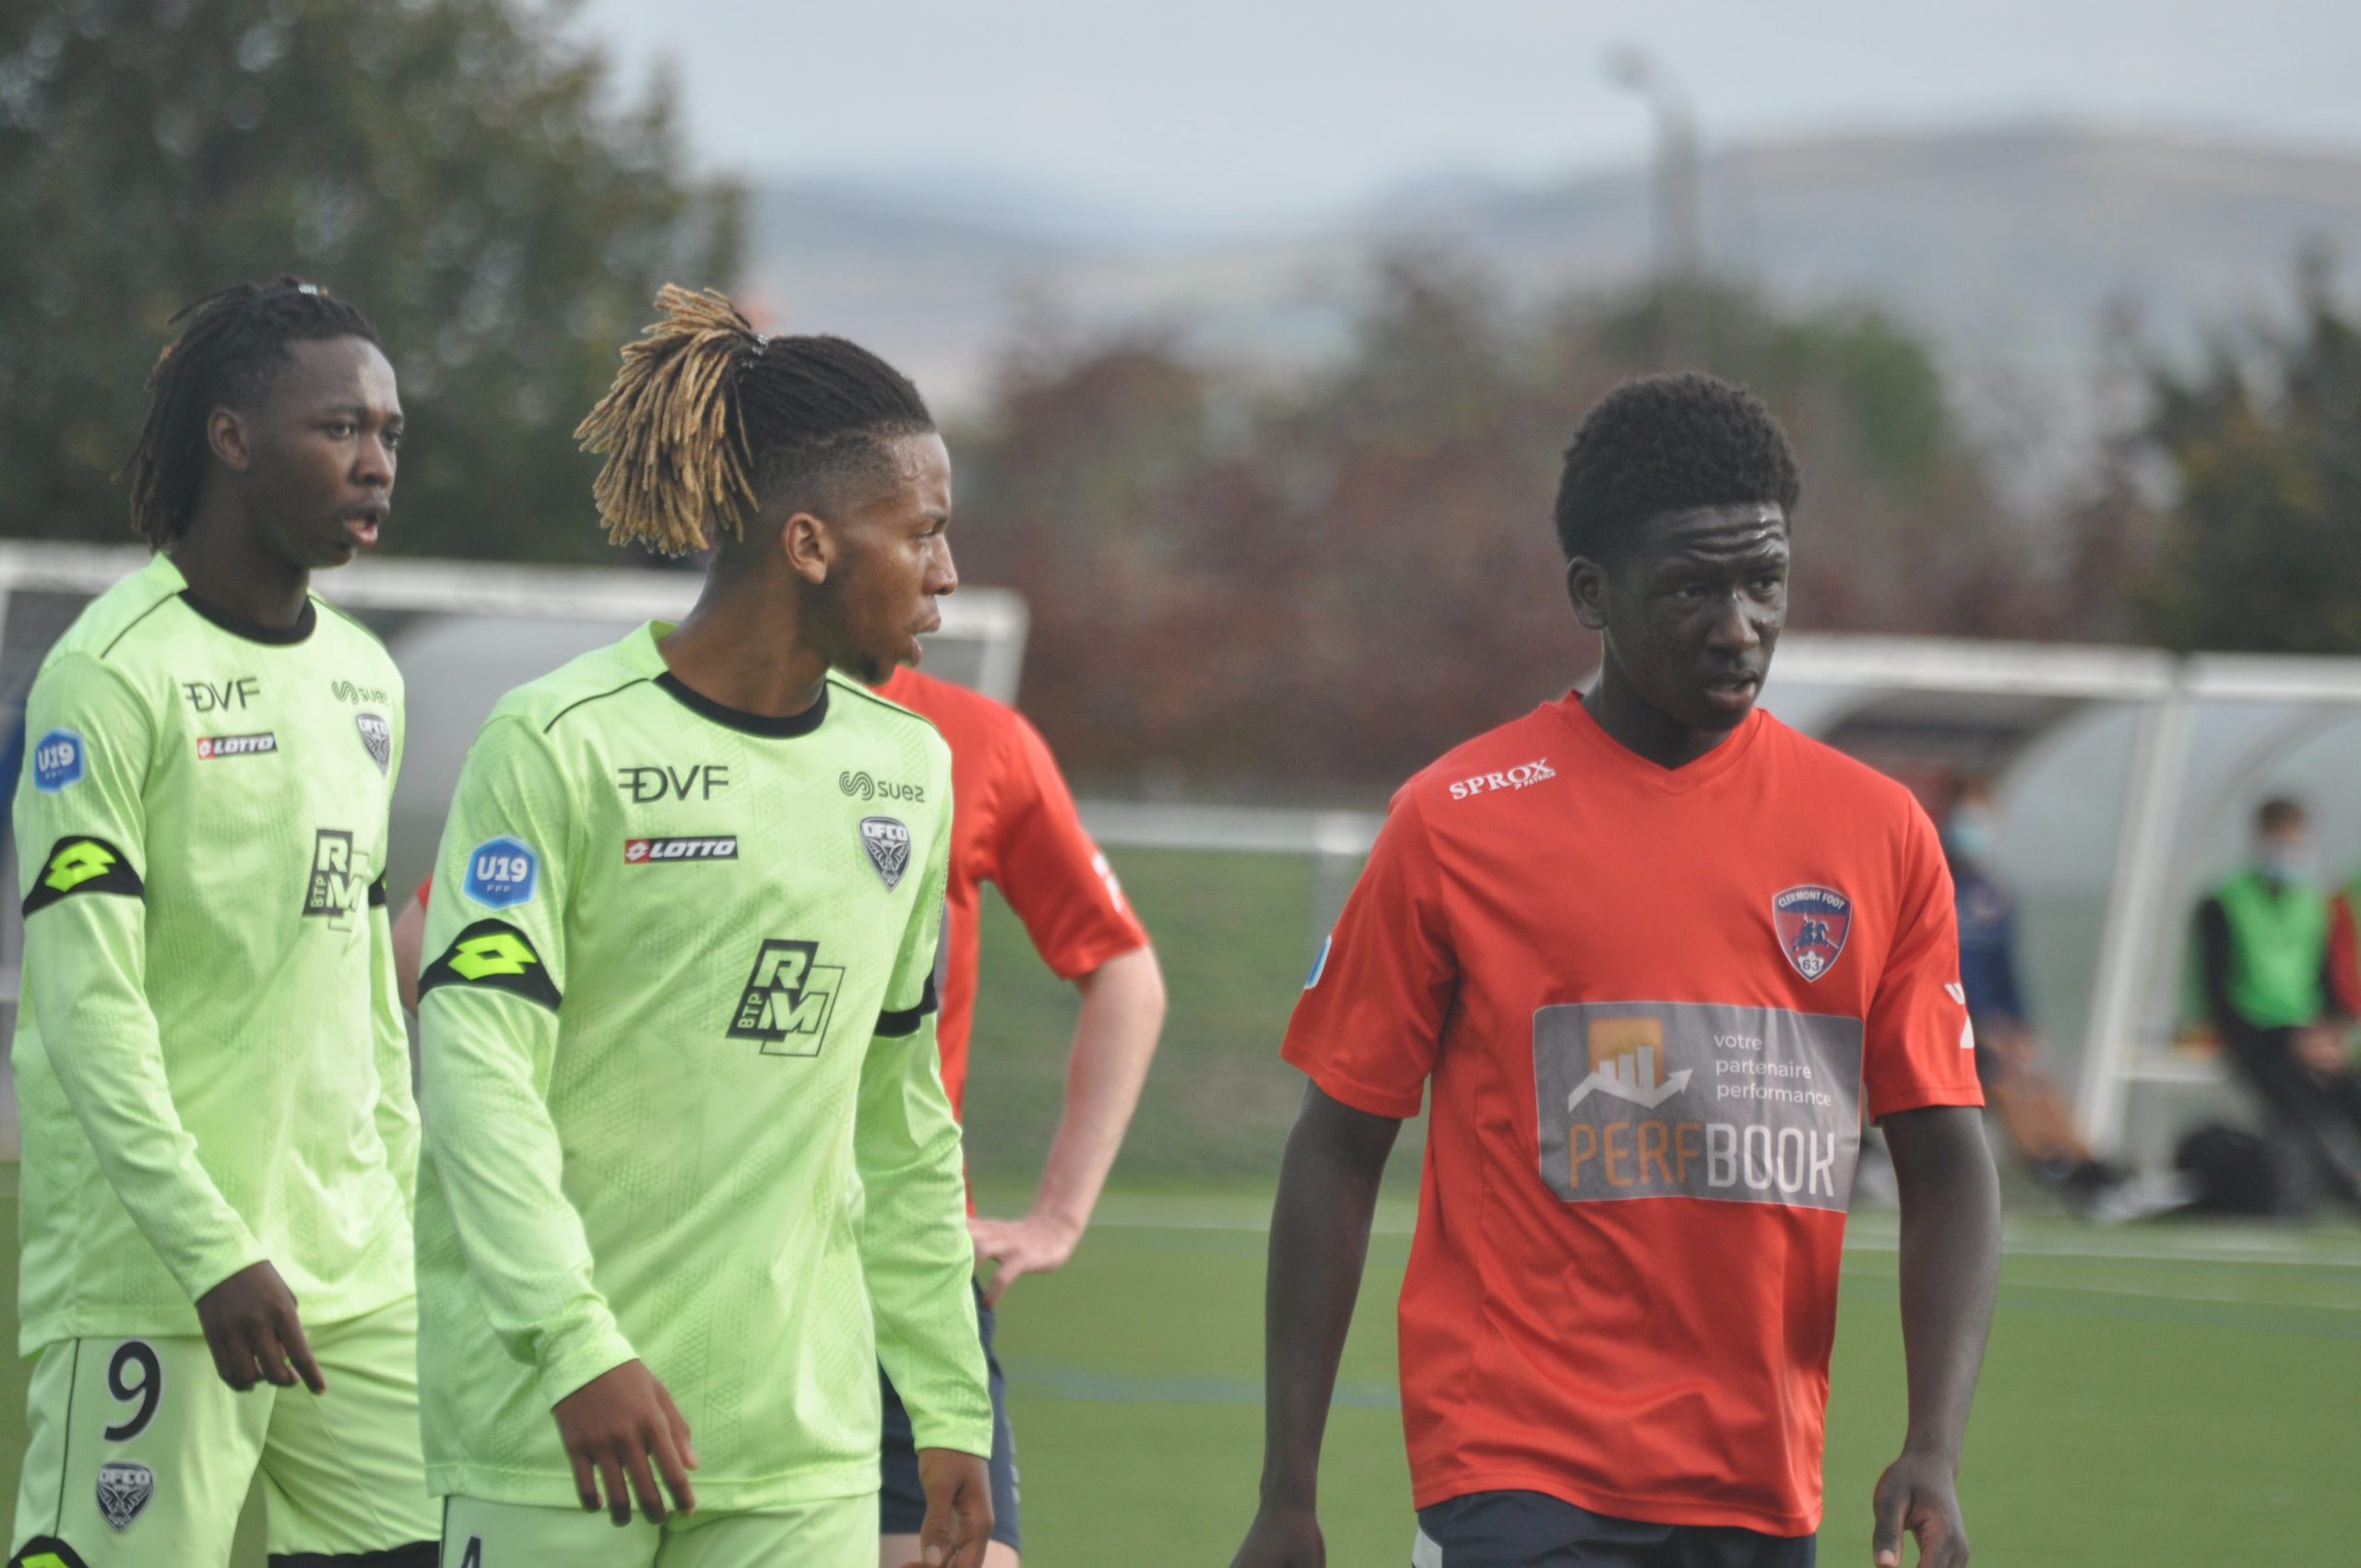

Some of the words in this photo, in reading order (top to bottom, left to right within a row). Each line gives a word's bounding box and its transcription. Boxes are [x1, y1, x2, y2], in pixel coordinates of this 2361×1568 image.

[38, 743, 75, 772] U19
[213, 737, 274, 755] LOTTO
[1449, 757, 1556, 801] SPROX
[877, 780, 925, 803] suez
[648, 840, 736, 858] LOTTO
[476, 856, 528, 883] U19
[310, 873, 326, 909] BTP
[1778, 891, 1821, 908] CLERMONT
[1822, 894, 1845, 910] FOOT
[1802, 959, 1820, 971] 63
[737, 992, 764, 1028] BTP
[1714, 1034, 1762, 1051] votre
[1716, 1060, 1812, 1079] partenaire
[1717, 1083, 1832, 1107] performance
[1569, 1120, 1834, 1197] PERFBOOK
[103, 1340, 162, 1442] 9
